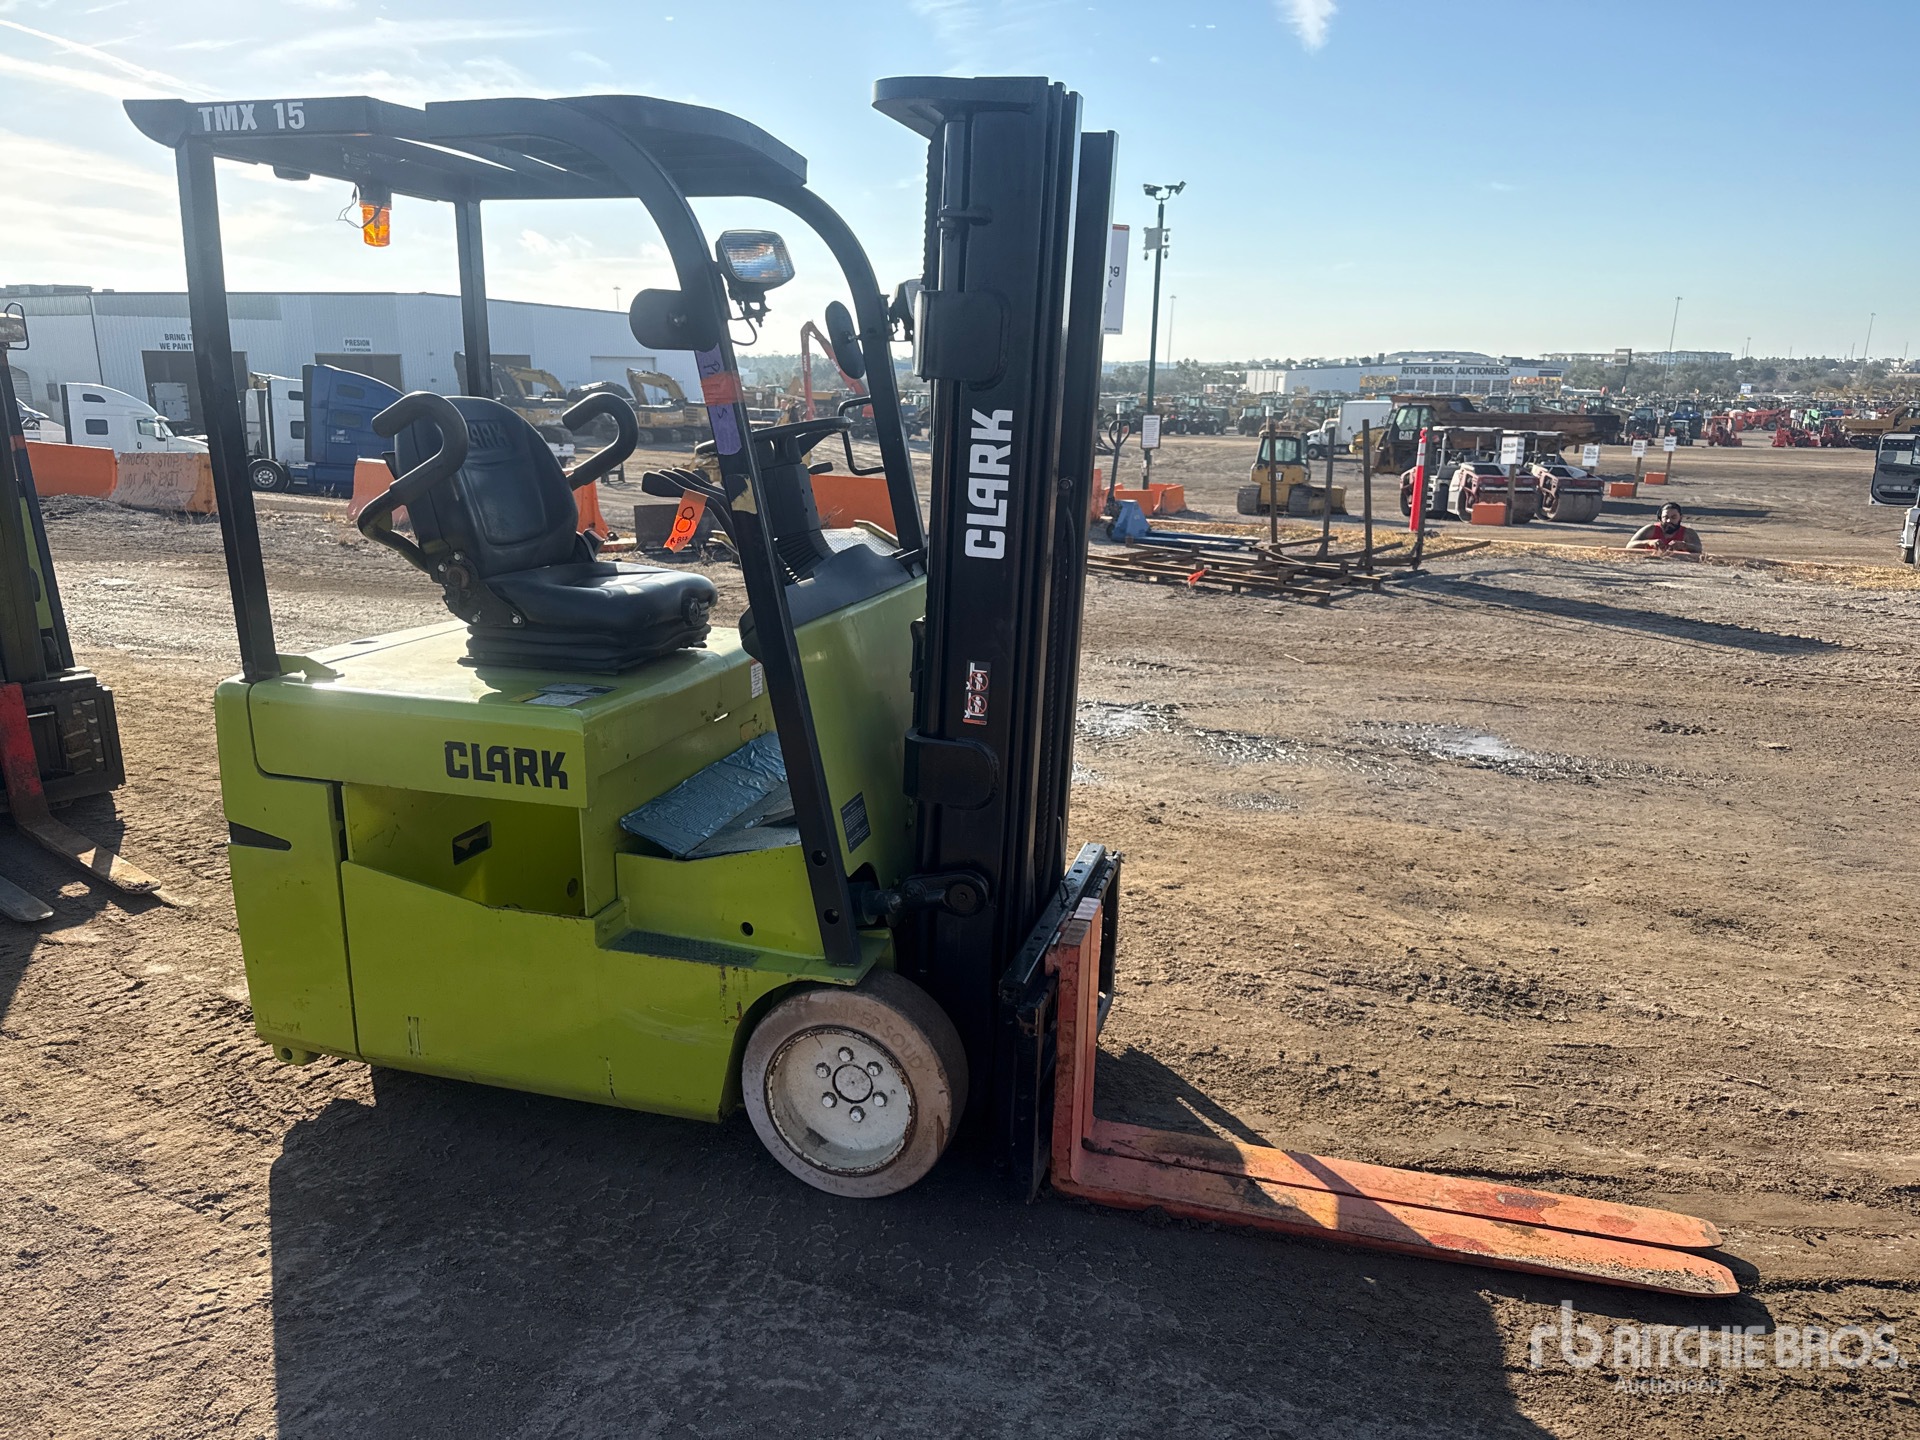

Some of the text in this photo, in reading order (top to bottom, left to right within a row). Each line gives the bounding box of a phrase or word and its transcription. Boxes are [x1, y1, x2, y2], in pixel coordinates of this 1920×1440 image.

[197, 102, 306, 132] TMX 15
[164, 333, 186, 341] BRING
[1401, 366, 1510, 376] RITCHIE BROS. AUCTIONEERS
[1398, 430, 1415, 441] CAT
[964, 407, 1014, 560] CLARK
[444, 740, 569, 790] CLARK
